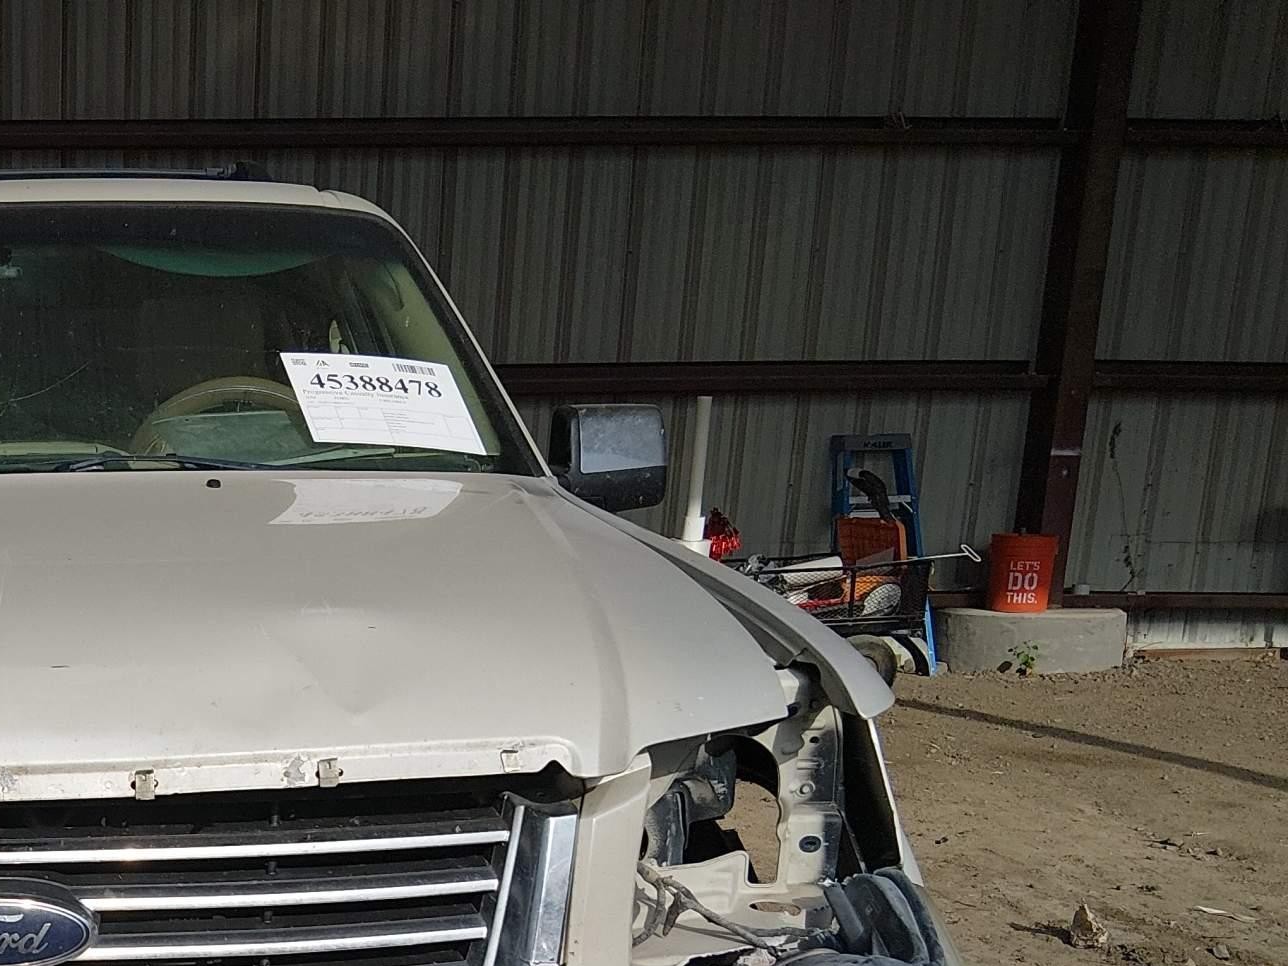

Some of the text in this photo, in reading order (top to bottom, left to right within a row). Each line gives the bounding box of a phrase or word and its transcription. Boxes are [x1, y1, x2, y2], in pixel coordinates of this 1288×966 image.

[310, 373, 443, 399] 45388478
[1010, 561, 1041, 571] LET'S
[1007, 571, 1038, 591] DO
[1006, 591, 1038, 604] THIS.
